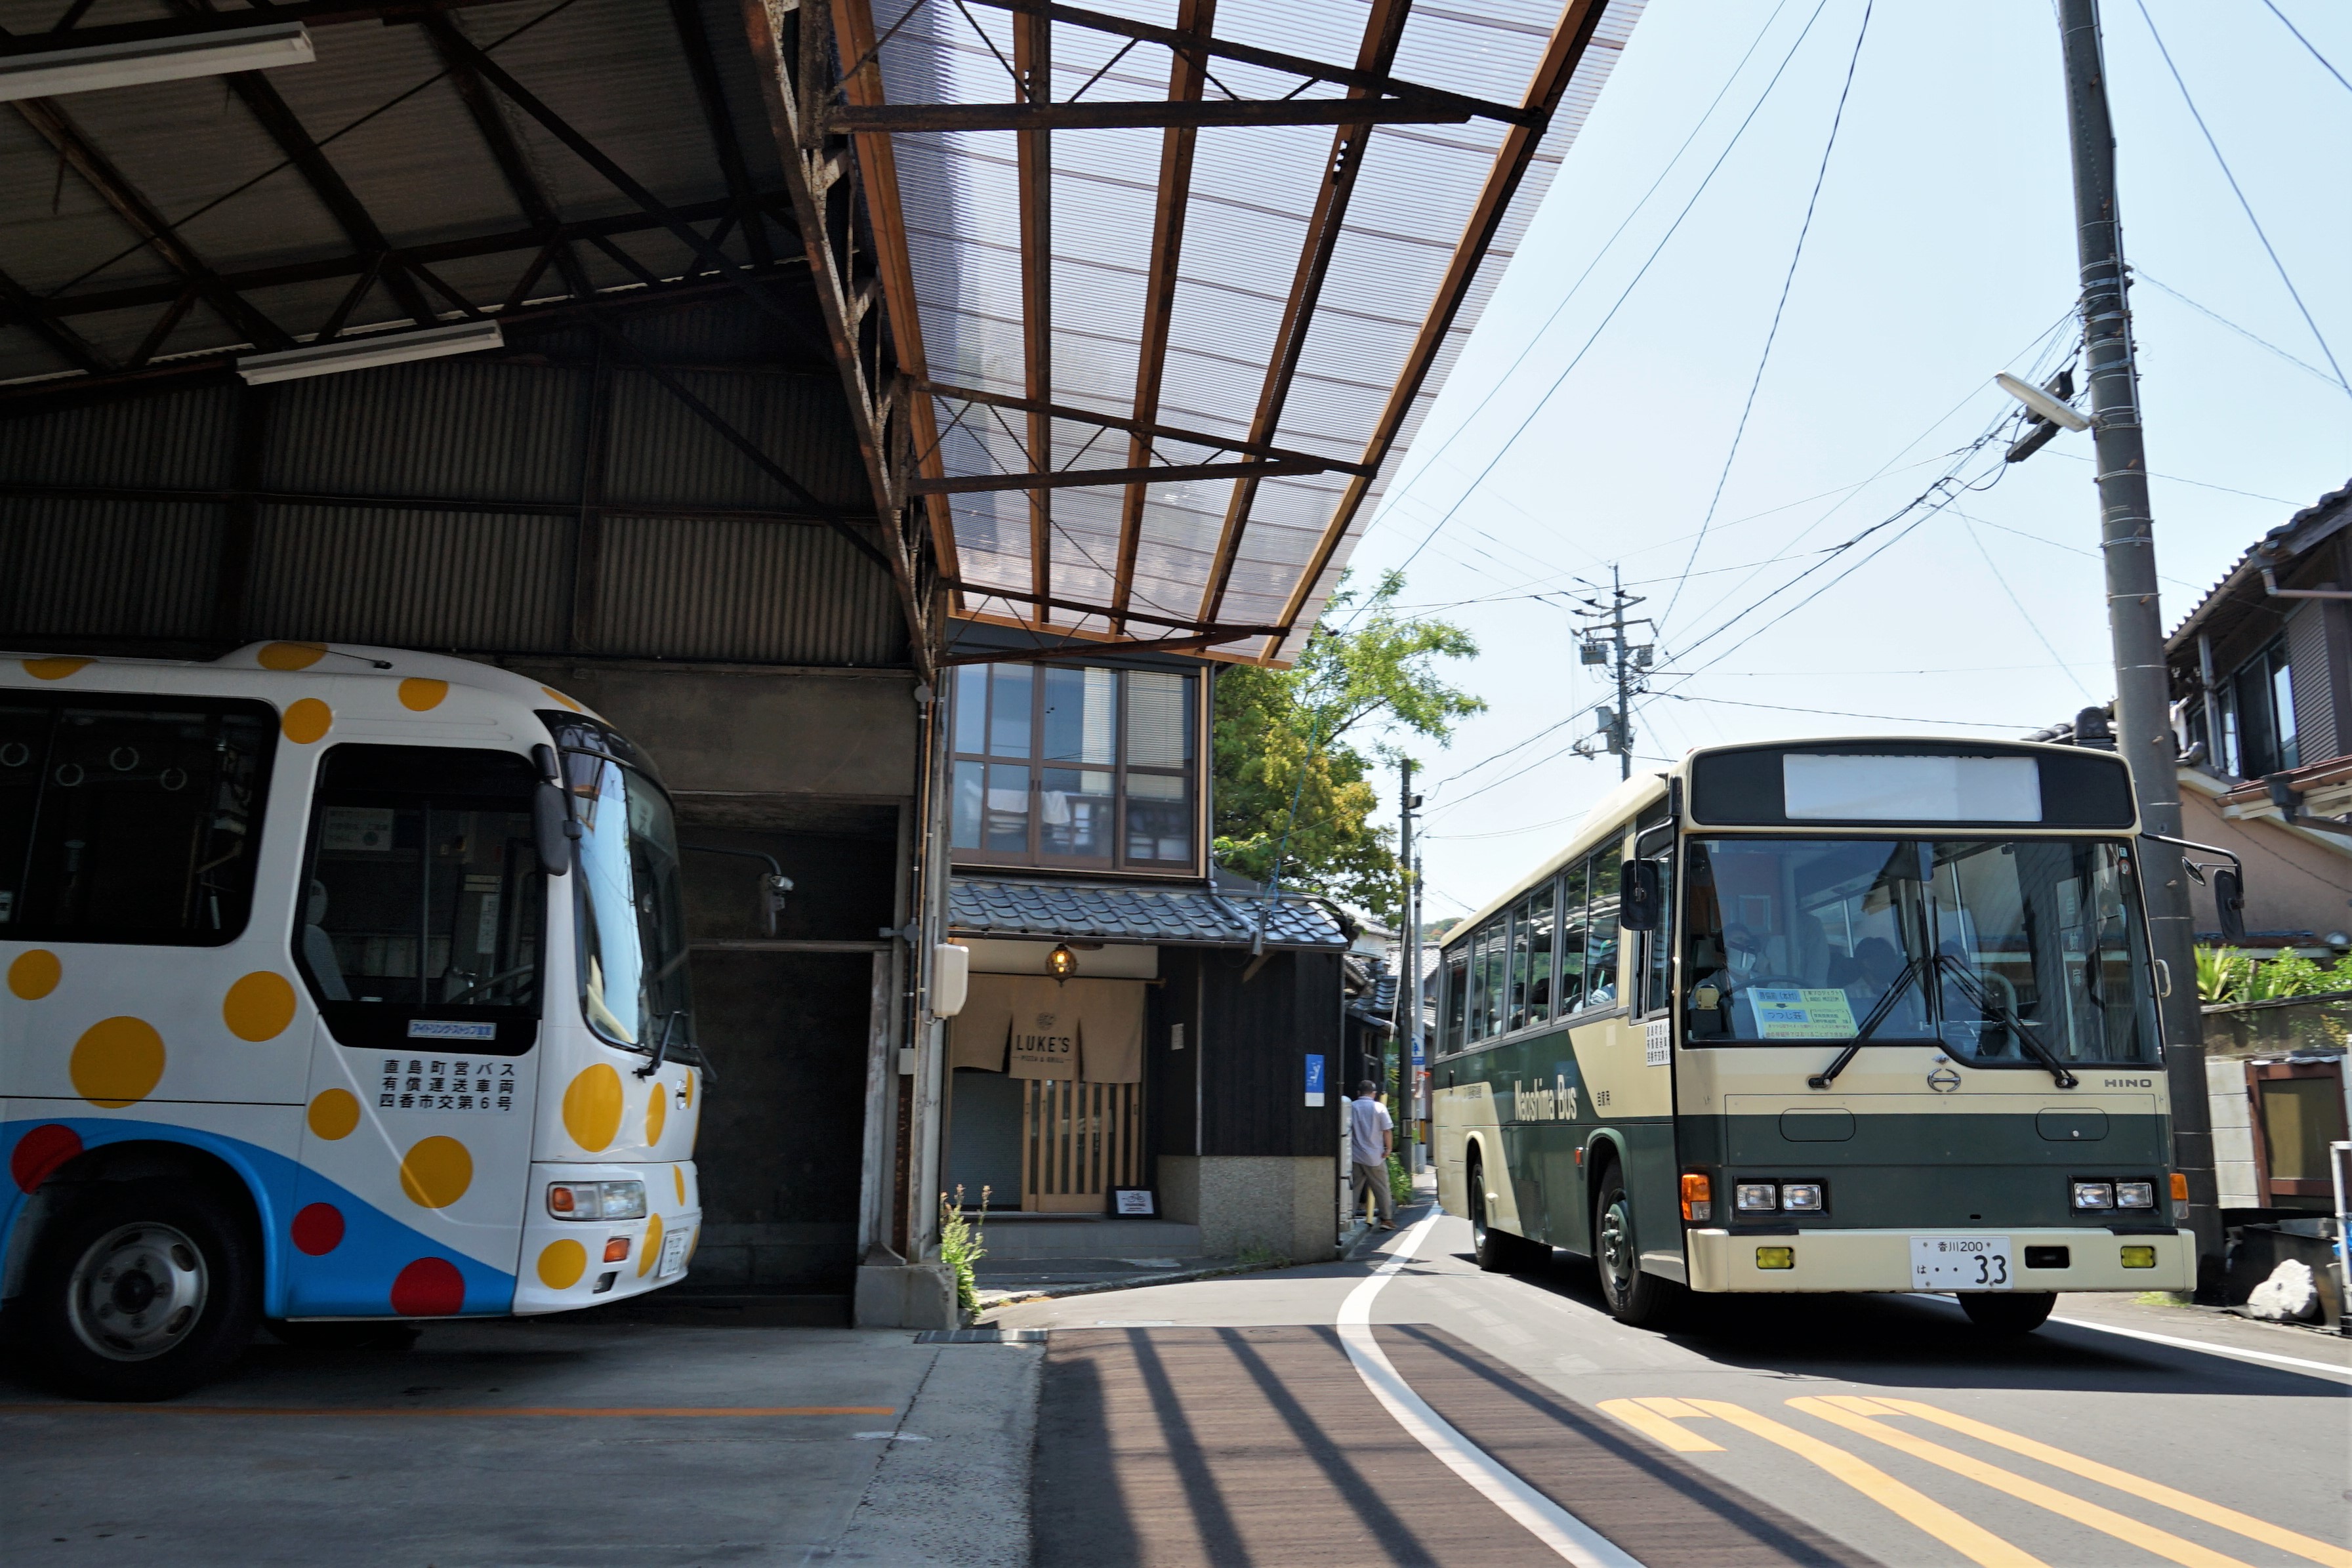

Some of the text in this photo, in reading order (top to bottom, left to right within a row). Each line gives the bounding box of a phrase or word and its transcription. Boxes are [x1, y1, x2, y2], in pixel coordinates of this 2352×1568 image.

[1017, 1035, 1070, 1053] LUKE'S
[384, 1059, 515, 1077] 直島町営バス
[382, 1076, 514, 1094] 有償運送車両
[2104, 1079, 2152, 1088] HINO
[379, 1093, 512, 1111] 四香市交第6号
[1515, 1075, 1577, 1121] Naoshima Bus
